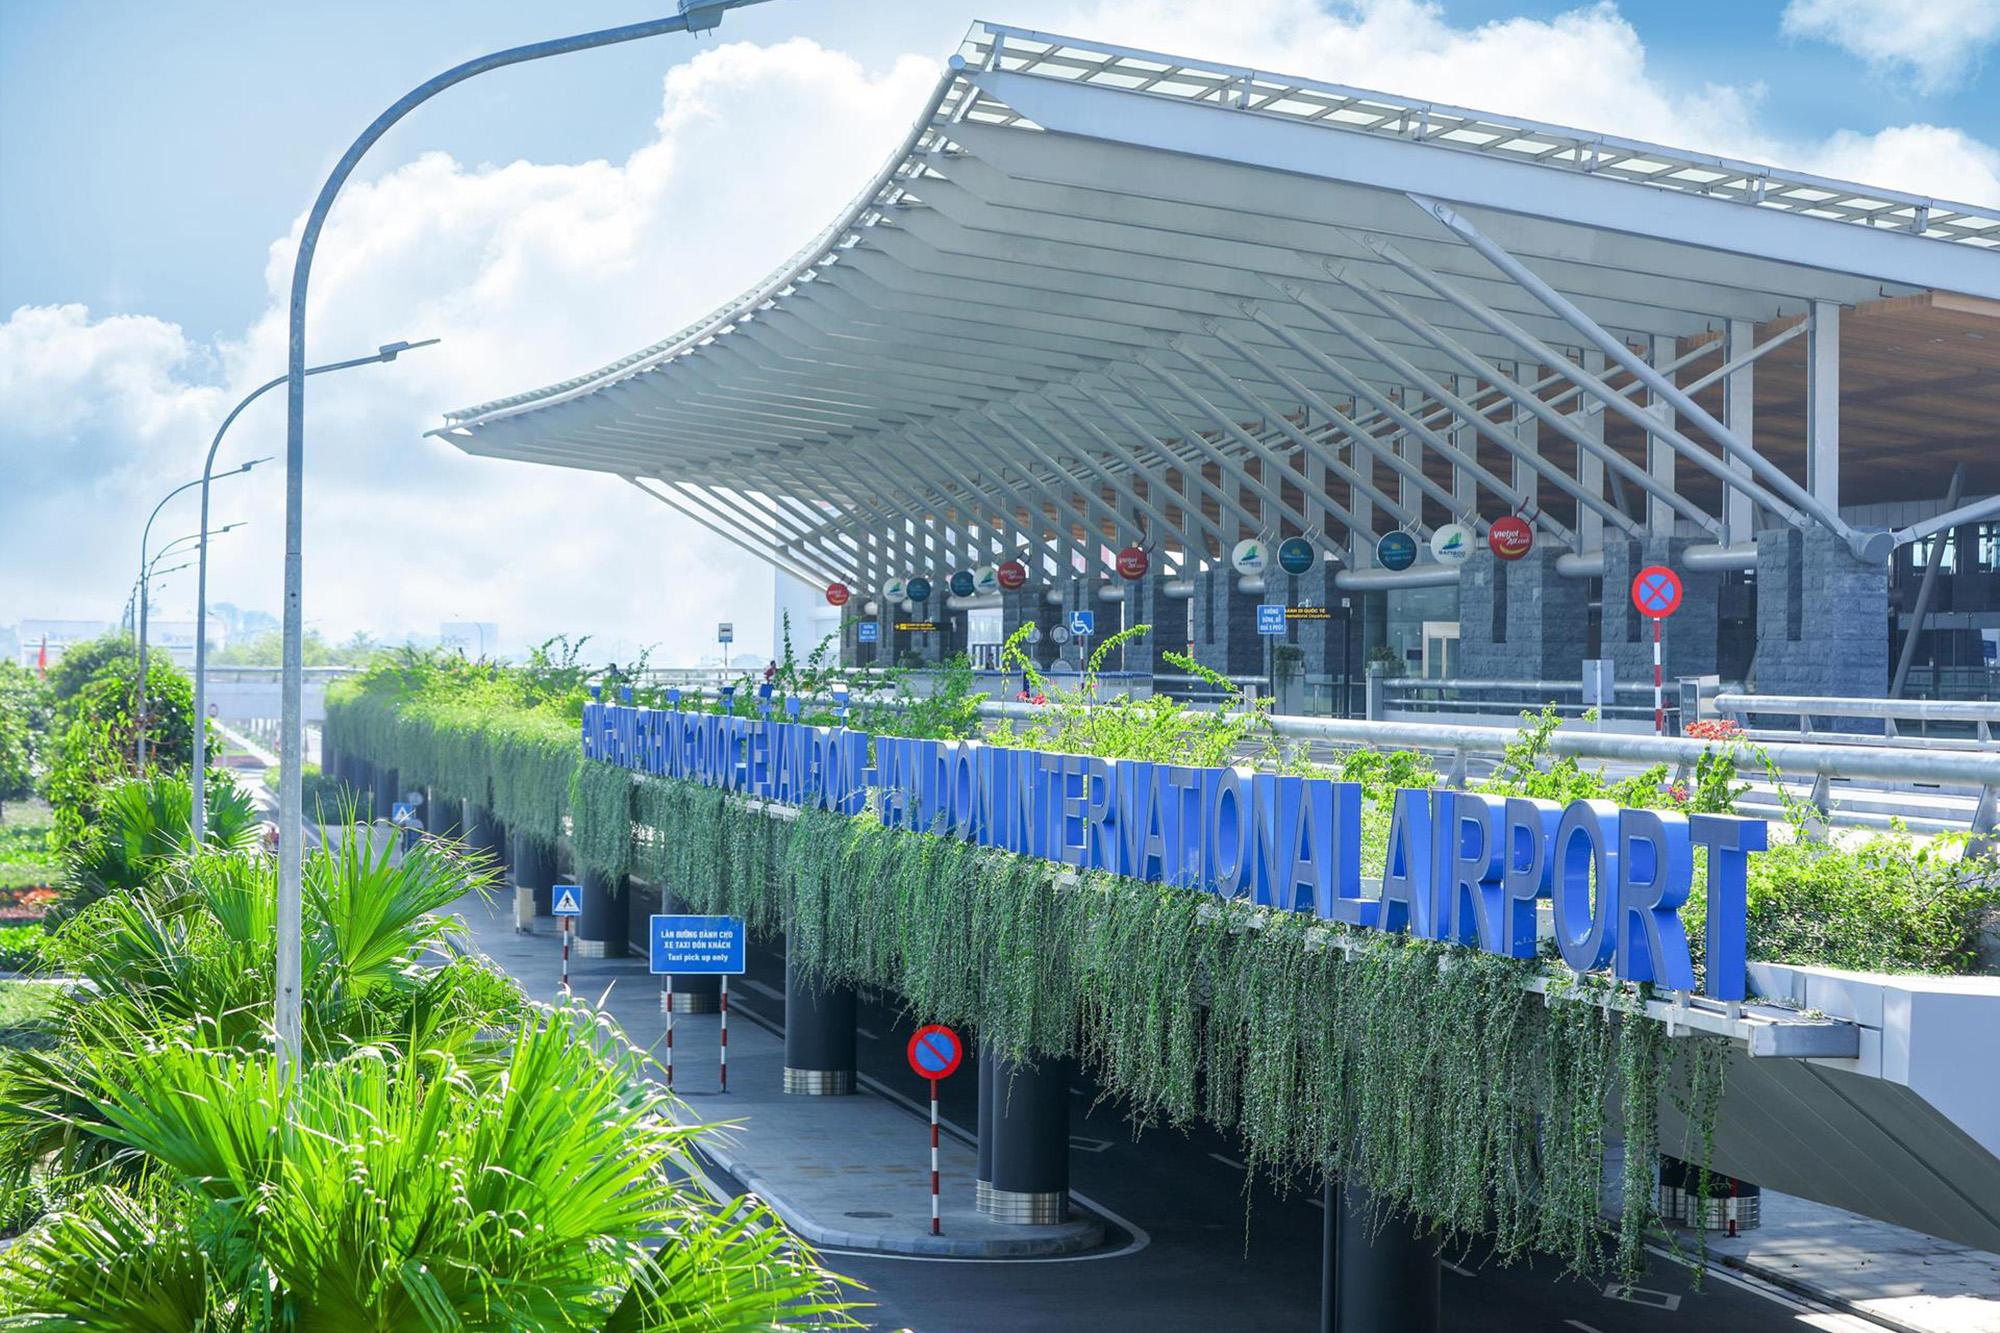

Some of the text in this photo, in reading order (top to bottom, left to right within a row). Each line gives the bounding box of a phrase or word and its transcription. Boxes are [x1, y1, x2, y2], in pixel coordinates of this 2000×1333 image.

[1005, 746, 1380, 927] INTERNATIONAL
[1376, 787, 1767, 1001] AIRPORT
[675, 941, 690, 949] TAXI
[684, 954, 700, 963] pick
[712, 954, 729, 963] only
